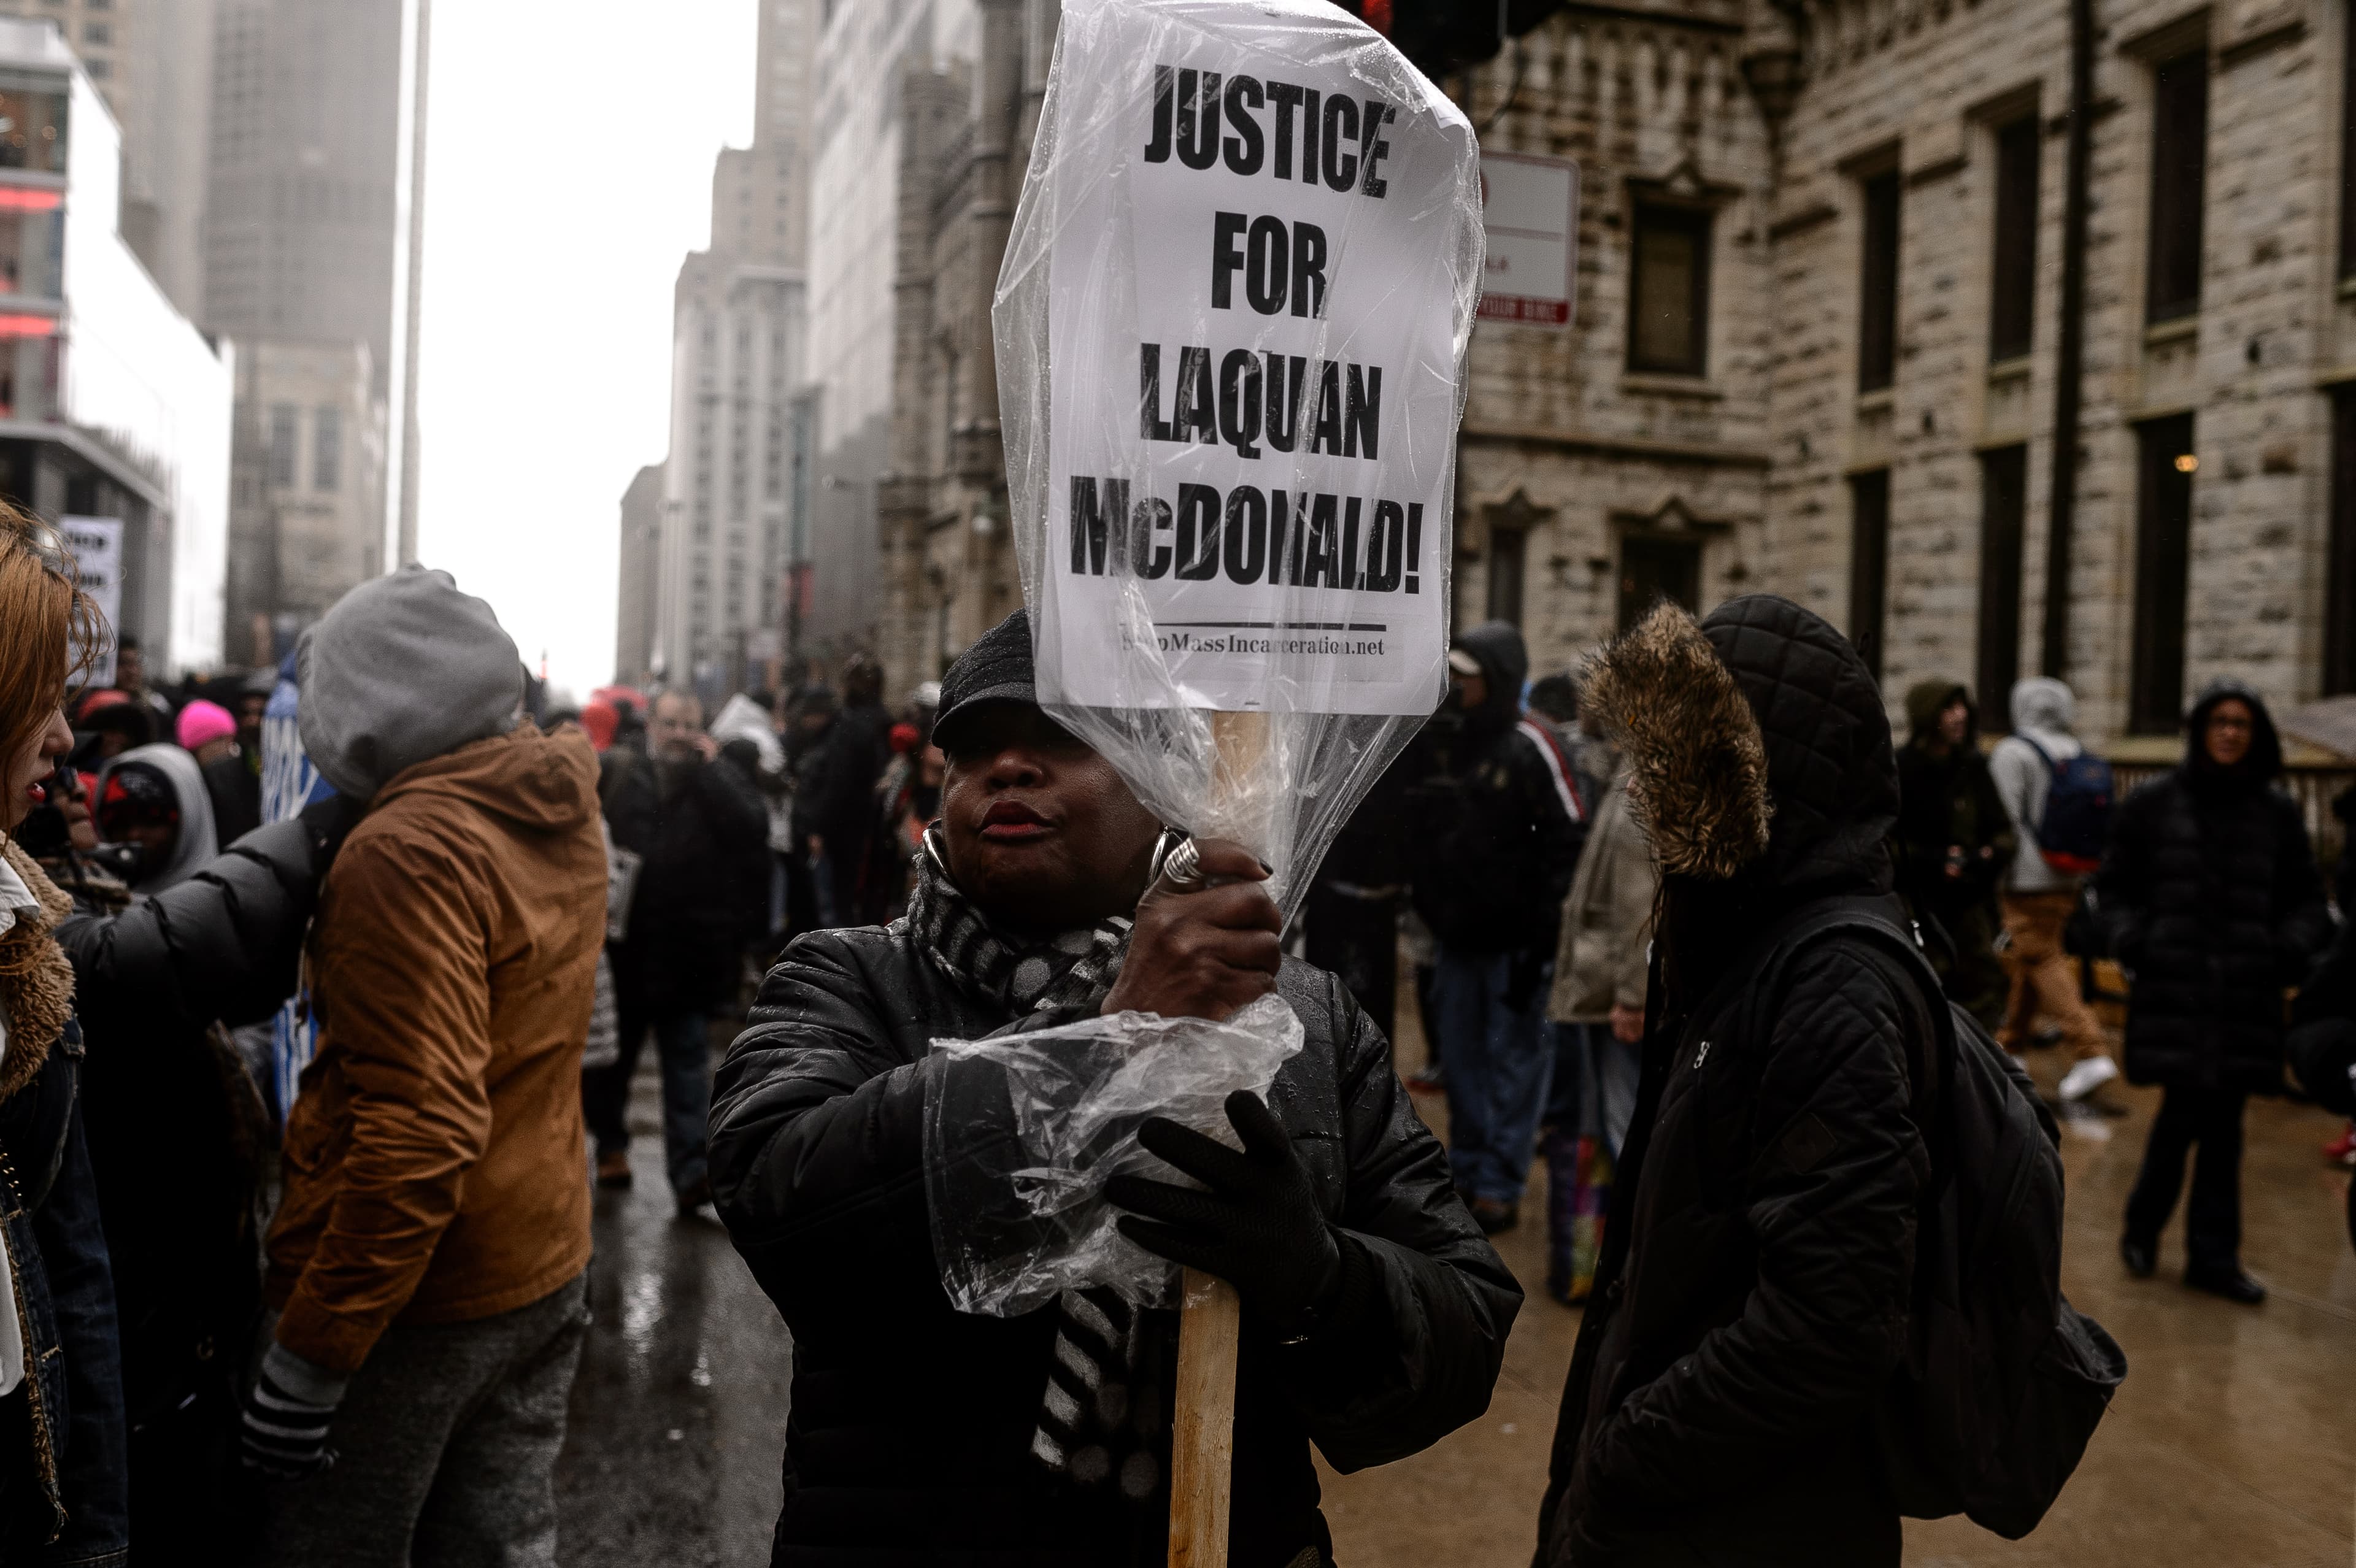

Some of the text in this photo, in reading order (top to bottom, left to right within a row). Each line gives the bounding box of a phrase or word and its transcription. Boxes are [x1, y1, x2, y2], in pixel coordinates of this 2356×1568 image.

[1144, 64, 1396, 199] JUSTICE
[1211, 211, 1328, 320] FOR
[1139, 342, 1382, 460] LAQUAN
[1070, 475, 1424, 594] McDONALD!
[1122, 632, 1385, 656] SpMassIncarceration.net
